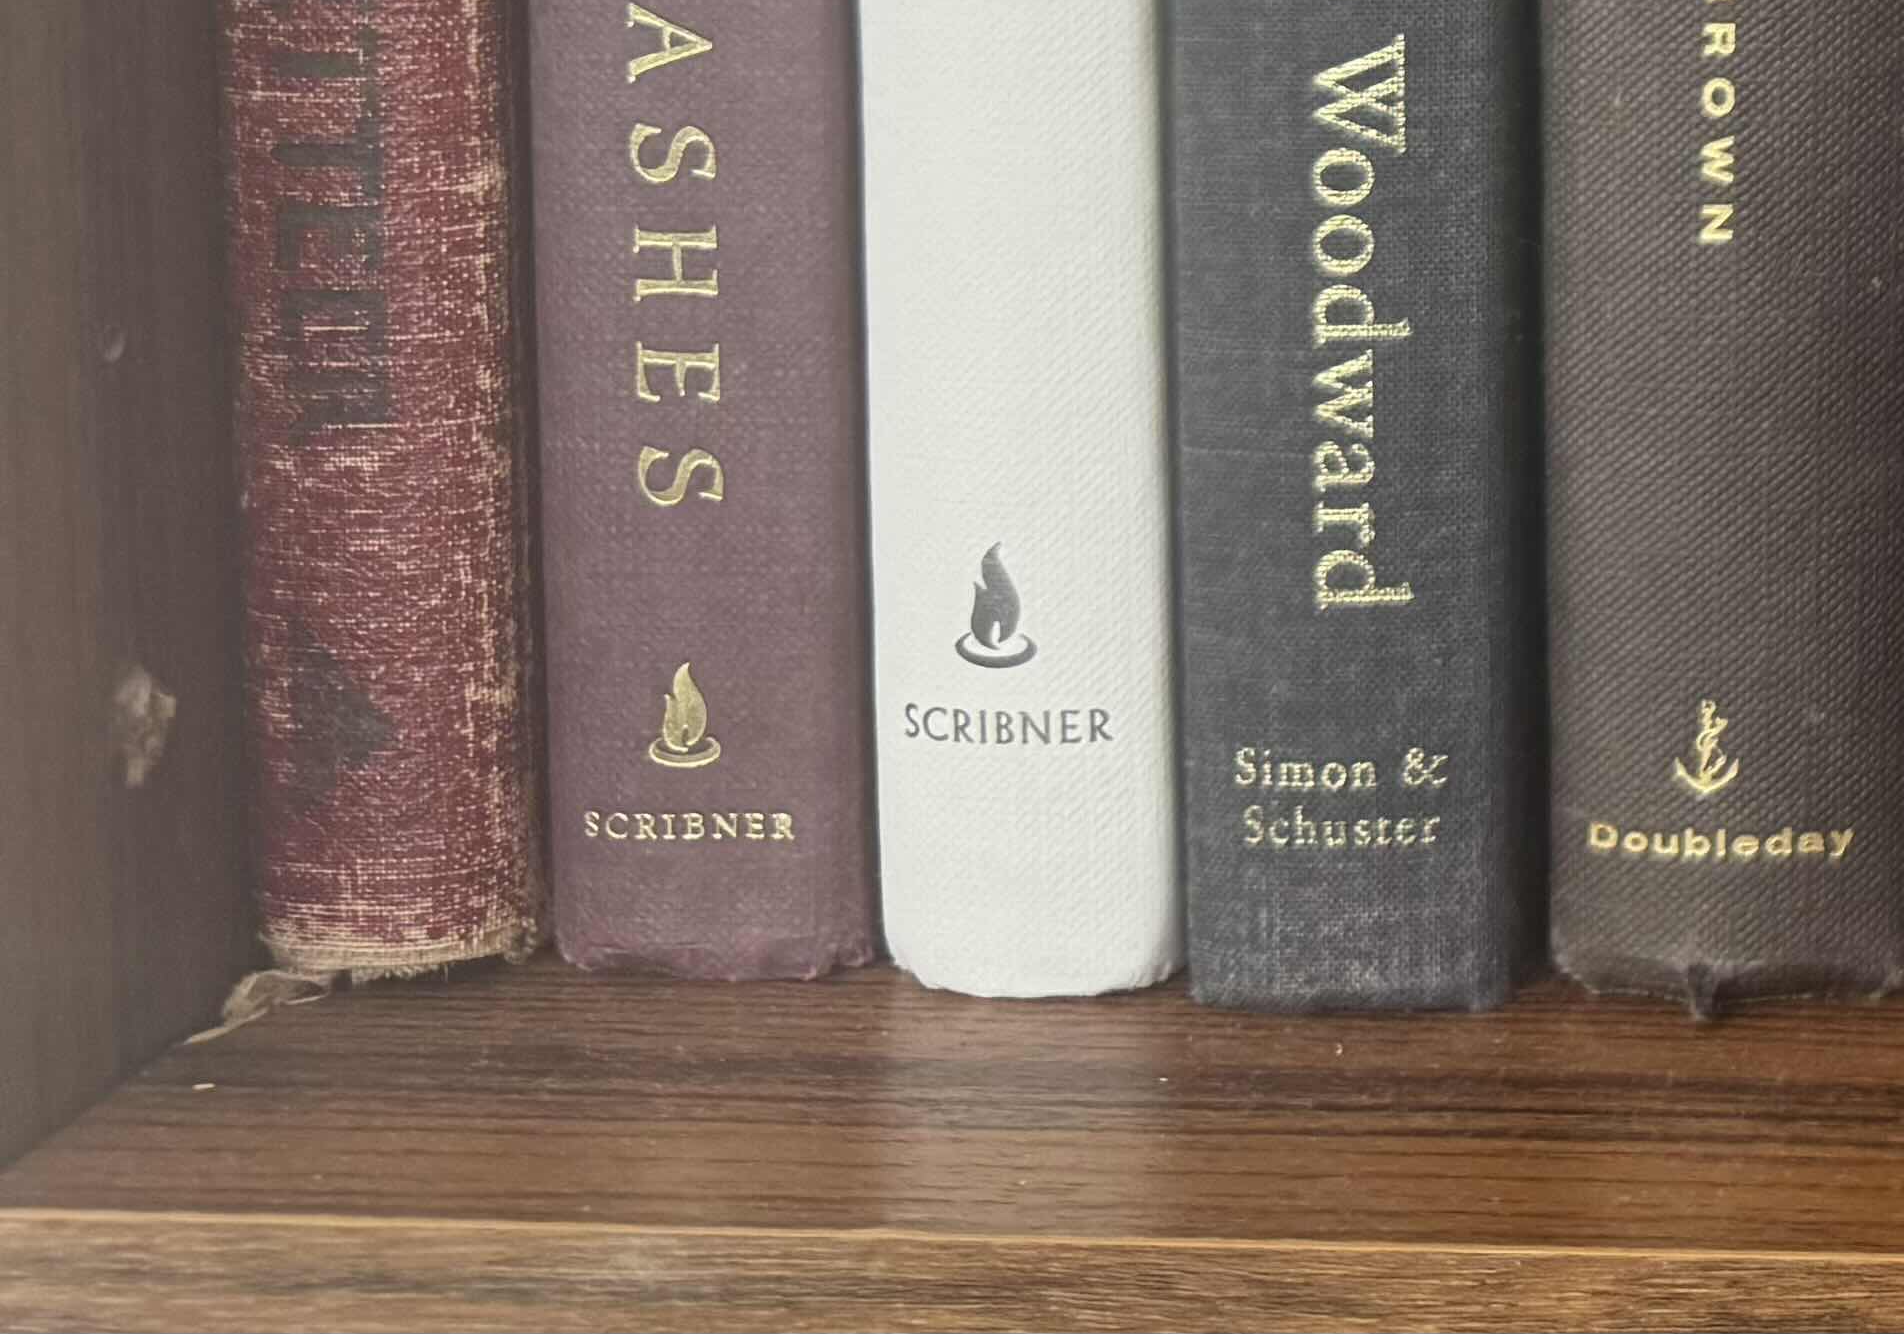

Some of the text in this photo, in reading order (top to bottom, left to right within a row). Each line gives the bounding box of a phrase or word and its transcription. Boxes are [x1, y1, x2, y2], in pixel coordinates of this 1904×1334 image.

[626, 2, 724, 509] ASHES
[1310, 33, 1415, 612] Woodward
[904, 702, 1114, 745] SCRIBNER
[1234, 745, 1449, 789] Simon &
[583, 810, 796, 842] SCRIBNER
[1242, 805, 1440, 848] Schuster
[1586, 821, 1855, 862] Doubleday
